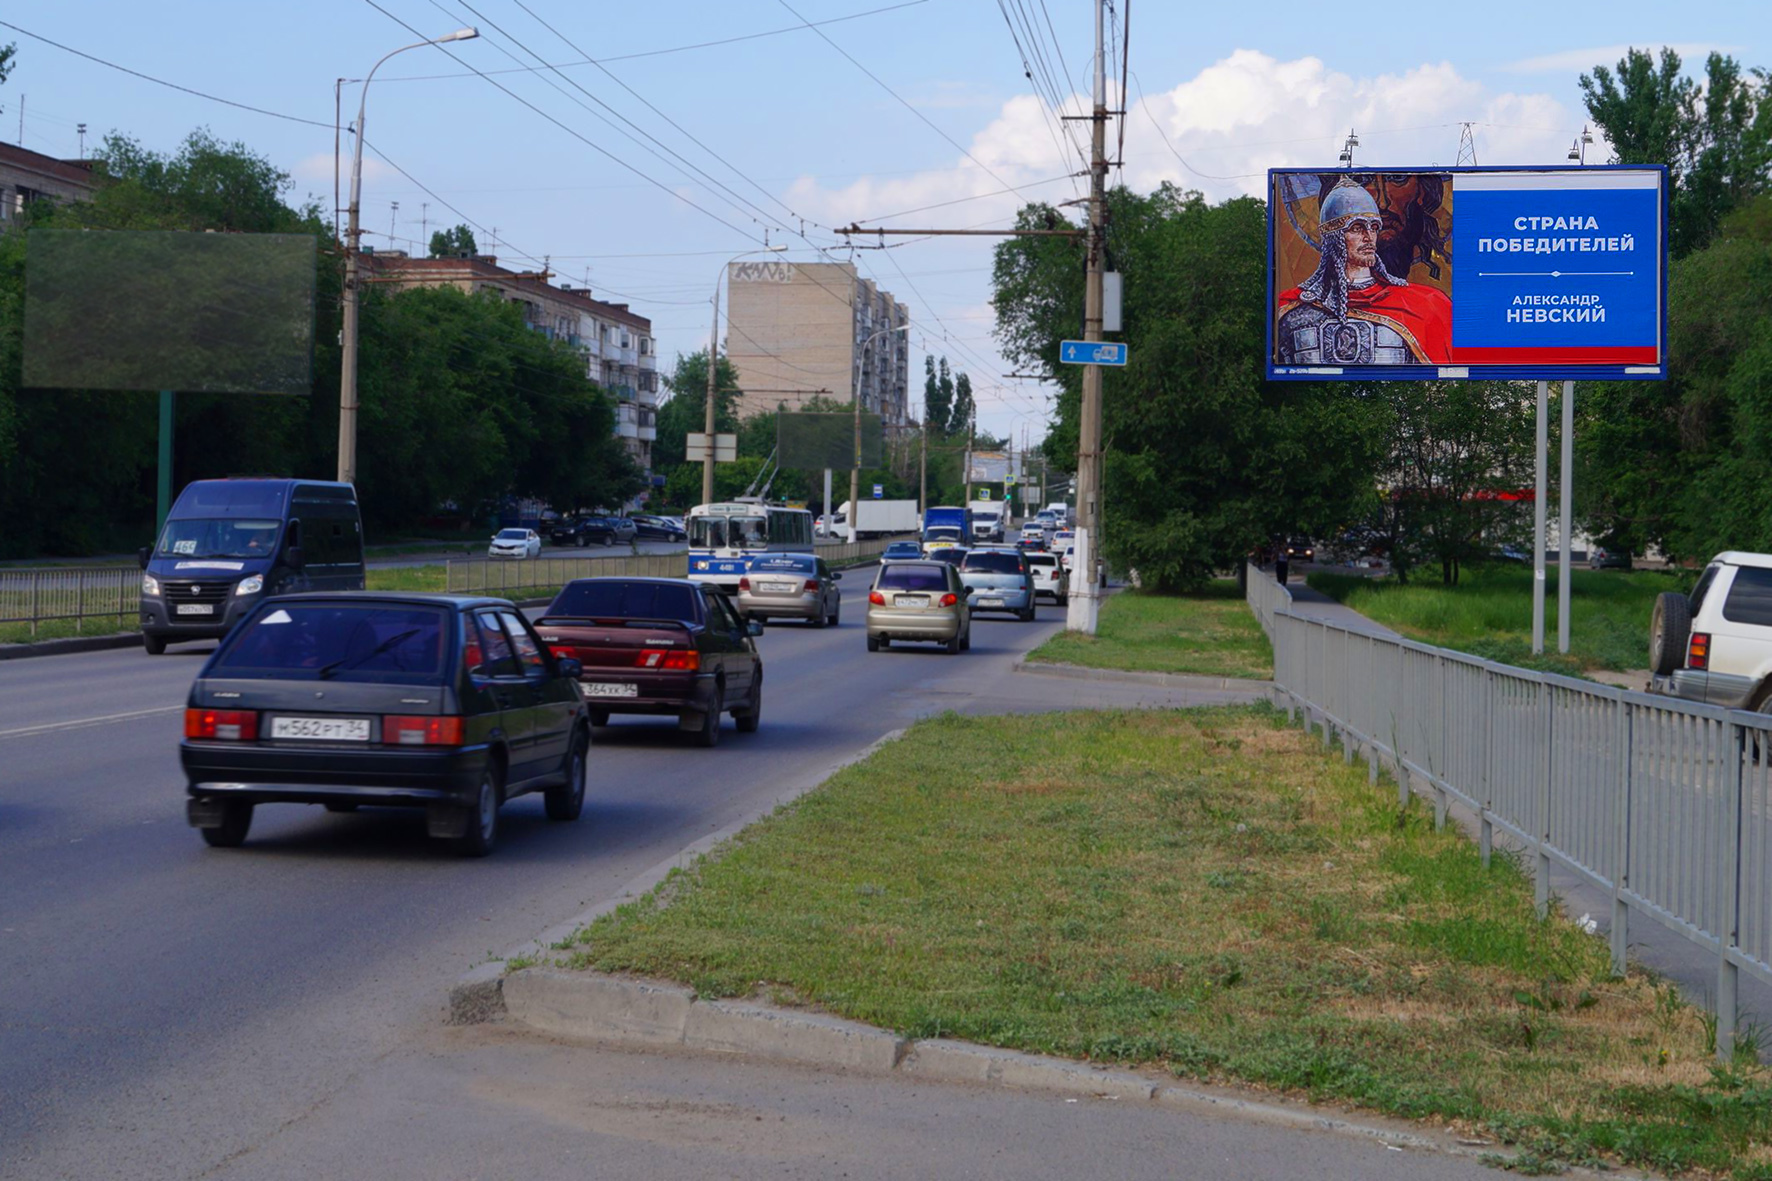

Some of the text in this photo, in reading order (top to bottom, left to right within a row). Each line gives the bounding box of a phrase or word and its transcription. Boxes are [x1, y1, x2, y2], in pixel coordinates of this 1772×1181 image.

[1514, 216, 1599, 231] СТРАНА
[1478, 233, 1635, 254] ПОБЕДИТЕЛЕЙ
[1512, 295, 1600, 306] АЛЕКСАНДР
[1506, 304, 1606, 323] НЕВСКИЙ
